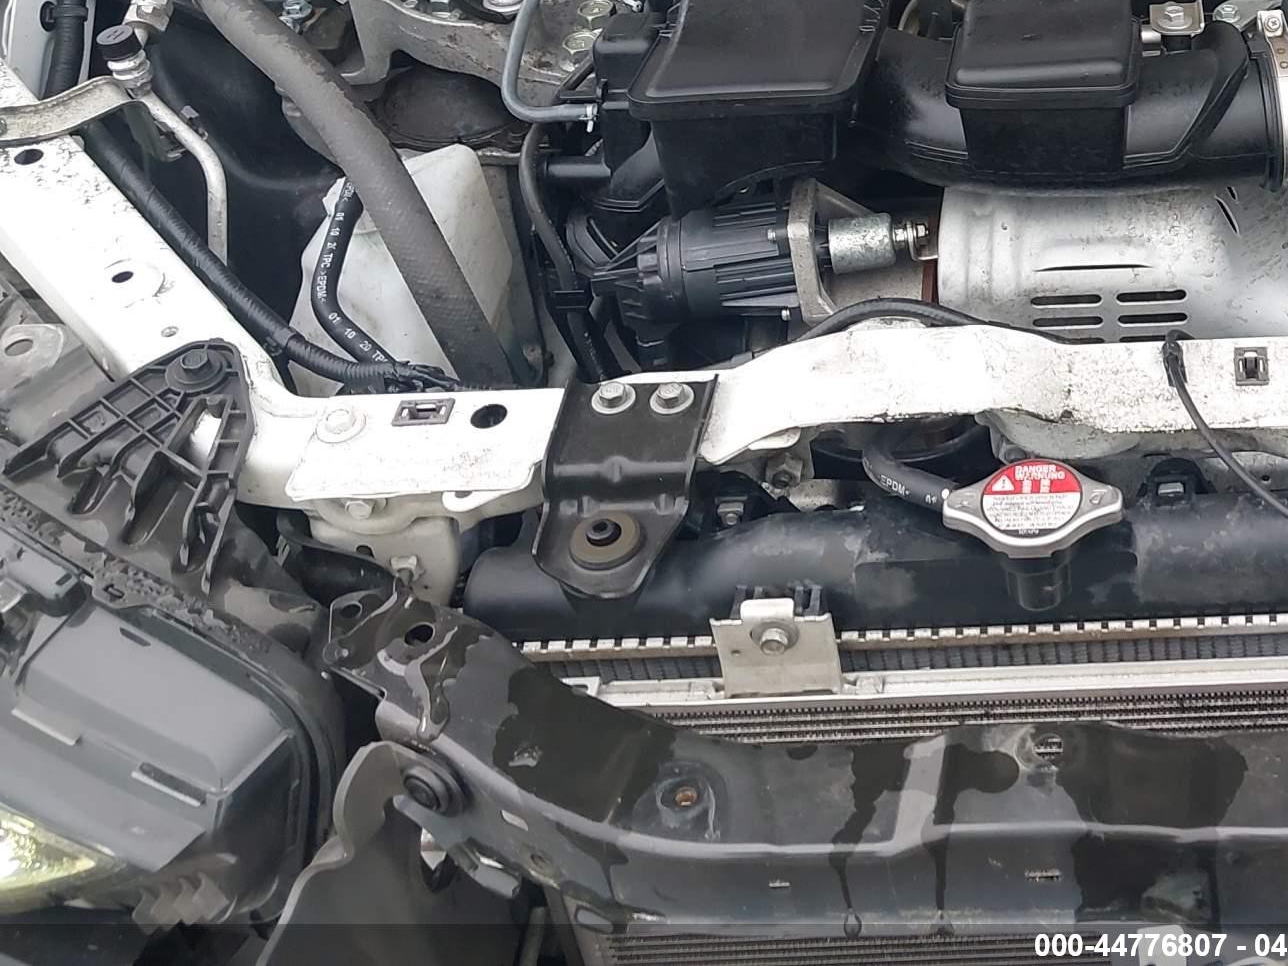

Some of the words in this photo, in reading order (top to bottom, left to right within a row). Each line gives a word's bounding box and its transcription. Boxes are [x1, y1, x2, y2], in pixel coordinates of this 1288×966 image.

[330, 227, 340, 236] 10
[321, 253, 334, 268] TPC
[328, 312, 341, 324] 01
[344, 328, 357, 340] 10
[359, 341, 372, 352] 20
[1015, 464, 1057, 473] DANGER
[1015, 471, 1066, 481] WARNING
